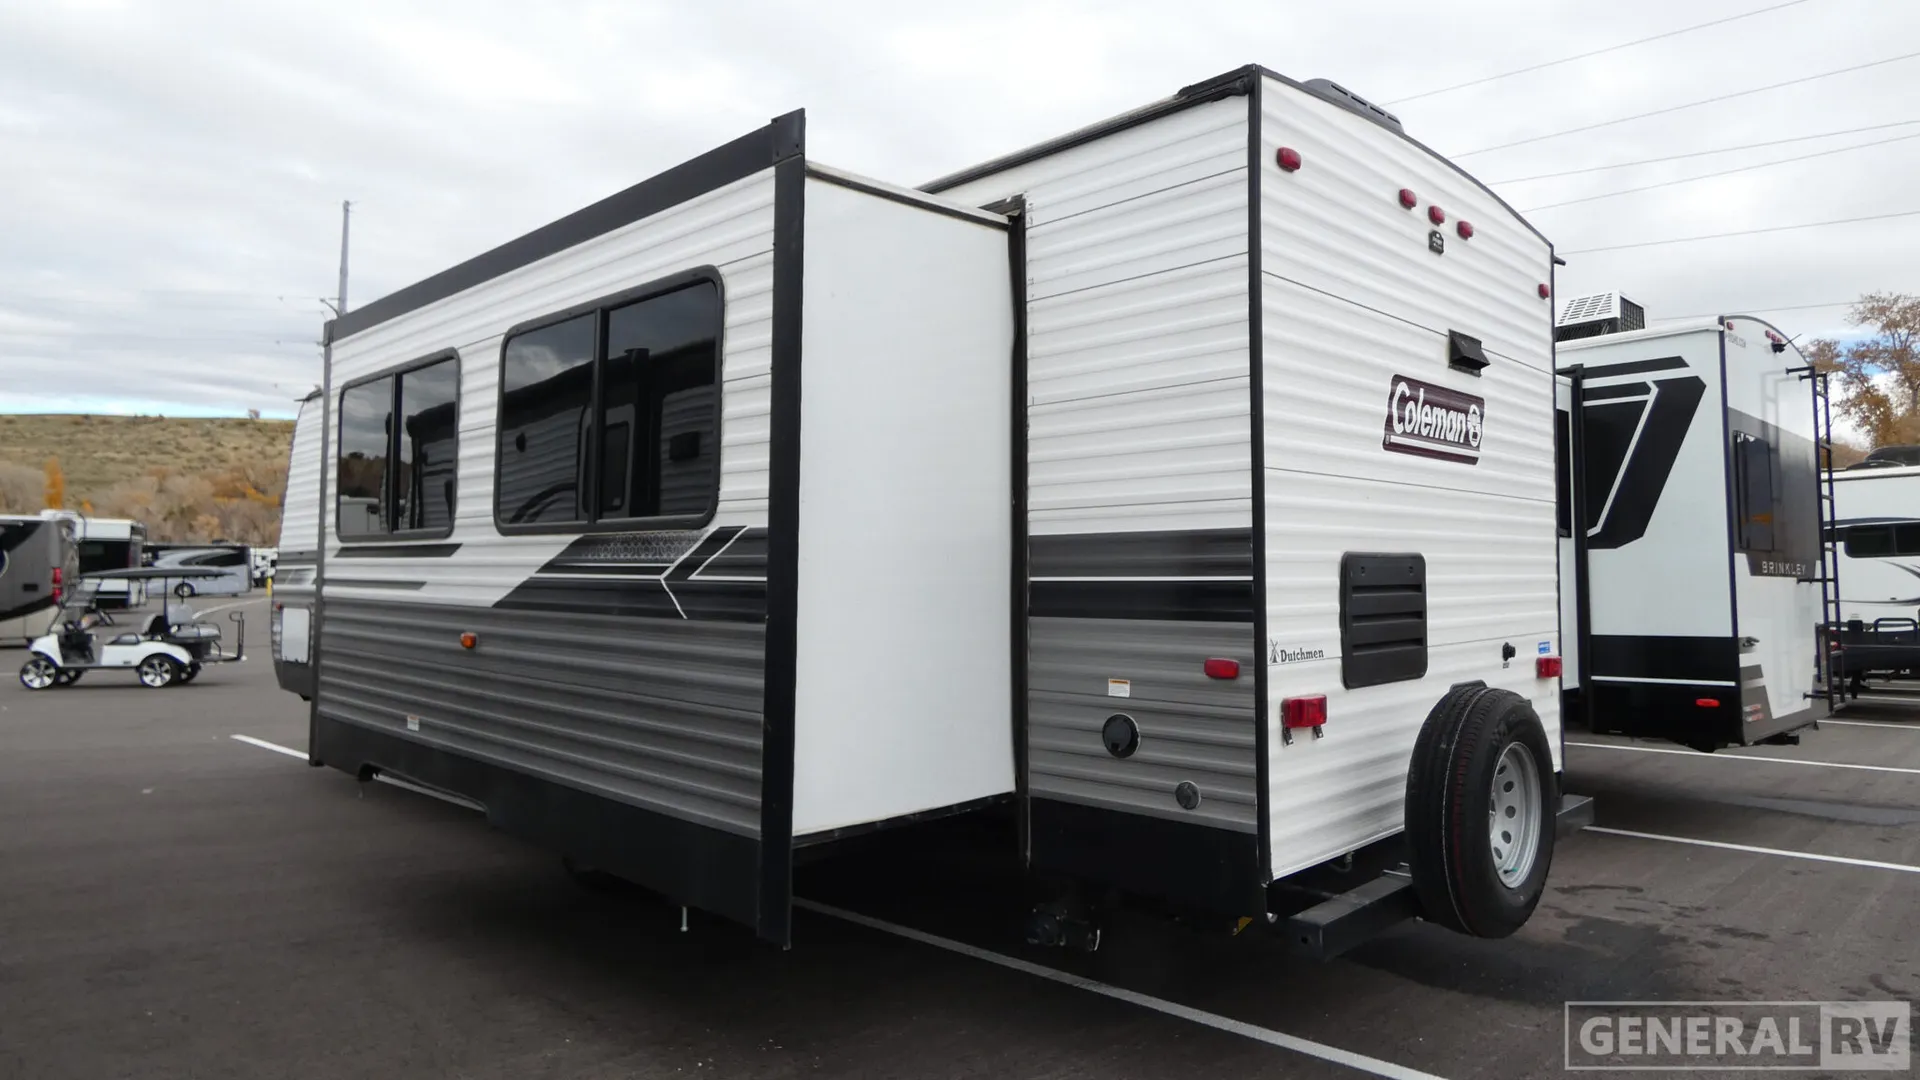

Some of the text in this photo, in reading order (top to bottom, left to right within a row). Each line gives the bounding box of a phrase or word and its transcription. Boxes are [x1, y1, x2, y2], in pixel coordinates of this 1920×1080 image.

[1392, 381, 1466, 443] Coleman
[1762, 560, 1806, 575] BRINKLEY
[1280, 647, 1324, 662] Dutchmen
